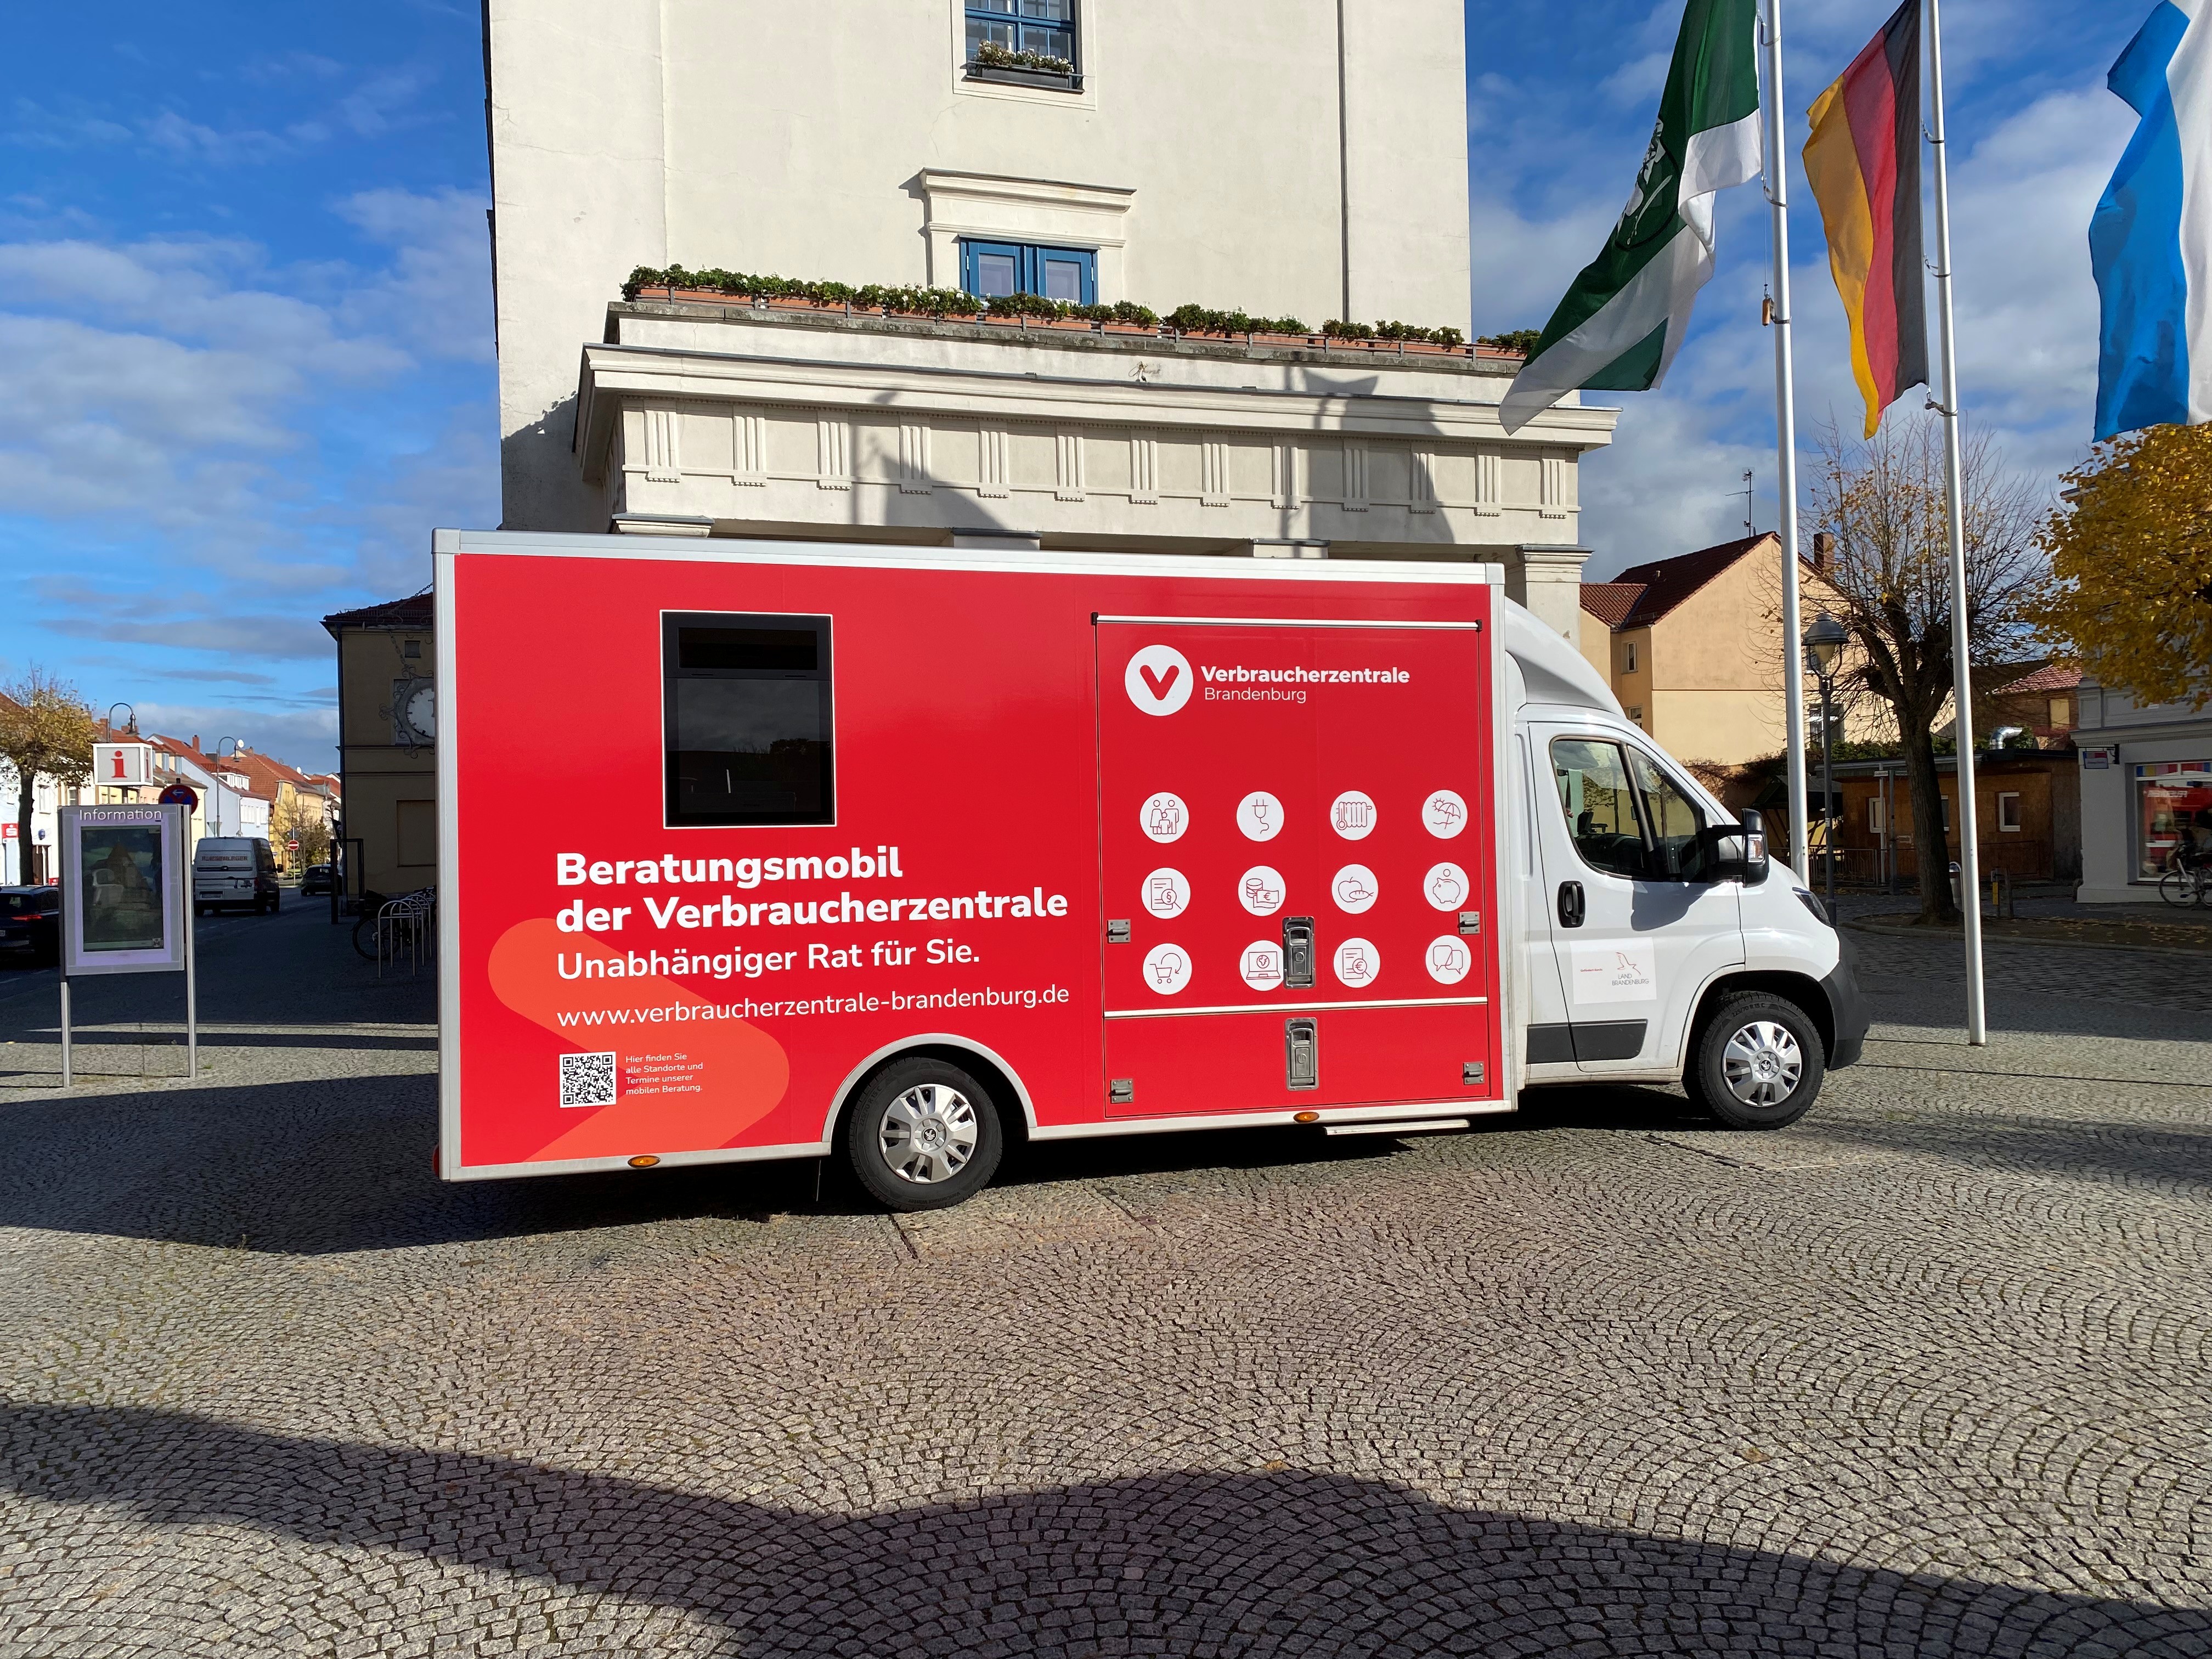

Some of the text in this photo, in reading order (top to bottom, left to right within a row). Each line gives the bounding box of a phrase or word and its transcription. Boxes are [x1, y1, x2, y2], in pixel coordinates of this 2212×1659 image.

[1200, 665, 1410, 683] Verbraucherzentrale
[1205, 686, 1307, 704] Brandenburg
[80, 808, 162, 821] Information
[556, 845, 904, 890] Beratungsmobil
[555, 887, 1068, 933] der Verbraucherzentrale
[557, 938, 980, 980] Unabhängiger Rat für Sie.
[557, 984, 1069, 1027] www.verbraucherzentrale-brandenburg.de
[625, 1055, 644, 1063] Hier
[645, 1053, 672, 1062] finden
[625, 1062, 703, 1074] alle Standorte und
[625, 1076, 660, 1085] Termine
[625, 1085, 703, 1095] mobilen Beratung.
